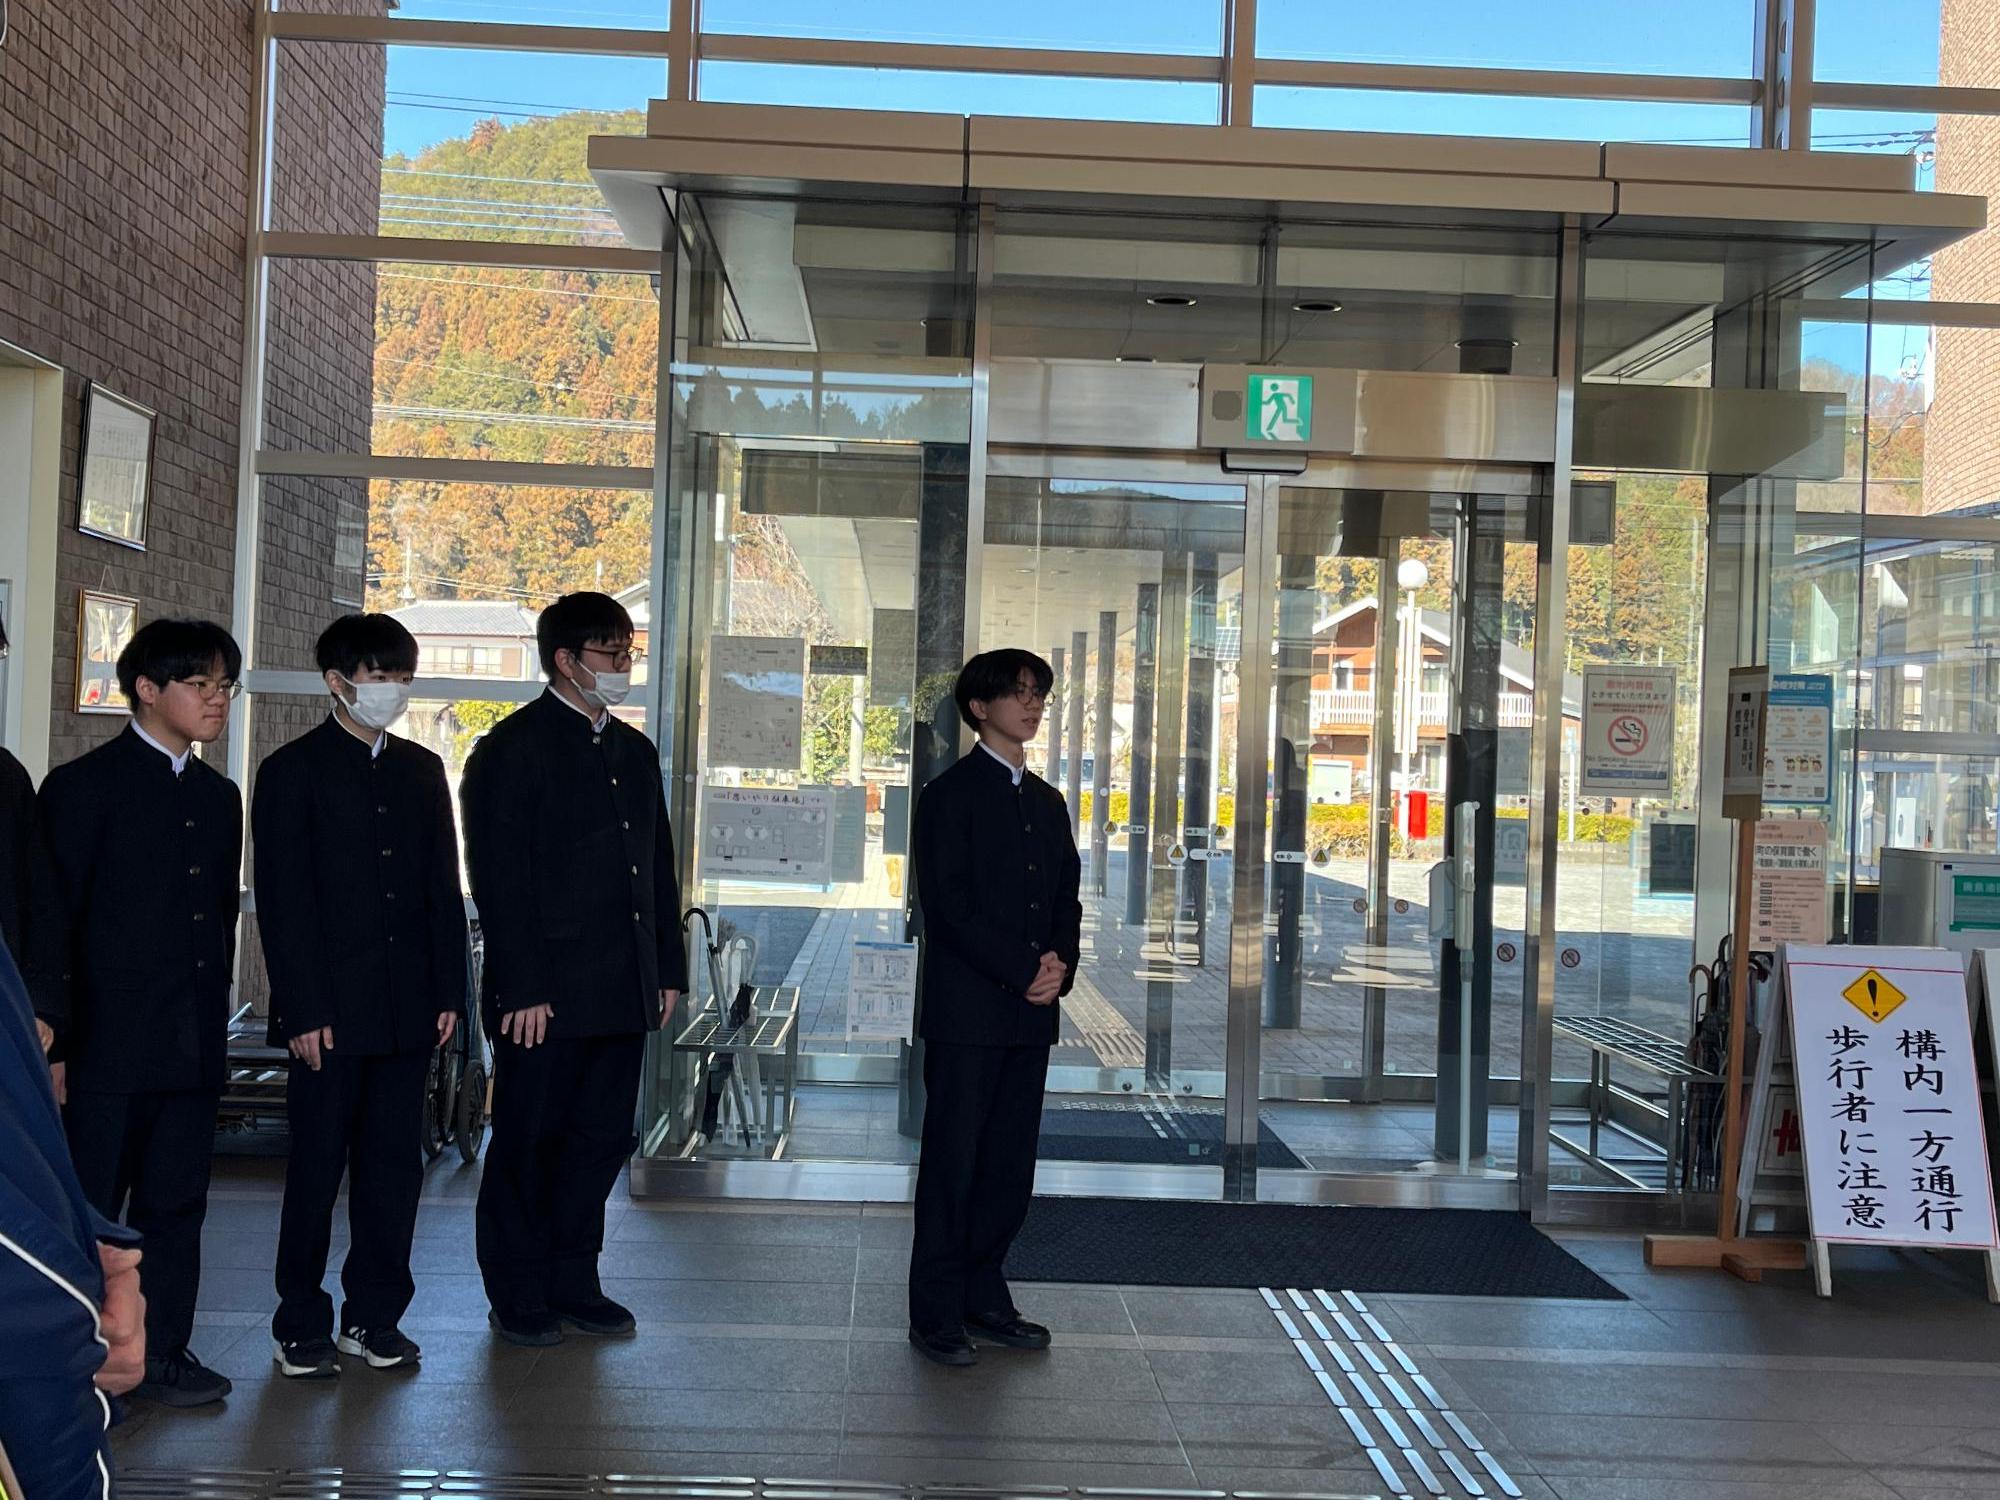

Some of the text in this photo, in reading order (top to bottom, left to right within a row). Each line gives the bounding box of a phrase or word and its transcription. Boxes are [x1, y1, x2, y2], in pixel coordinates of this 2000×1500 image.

[1825, 1025, 1888, 1230] 歩行者に注意
[1896, 1029, 1964, 1233] 構内一方通行
